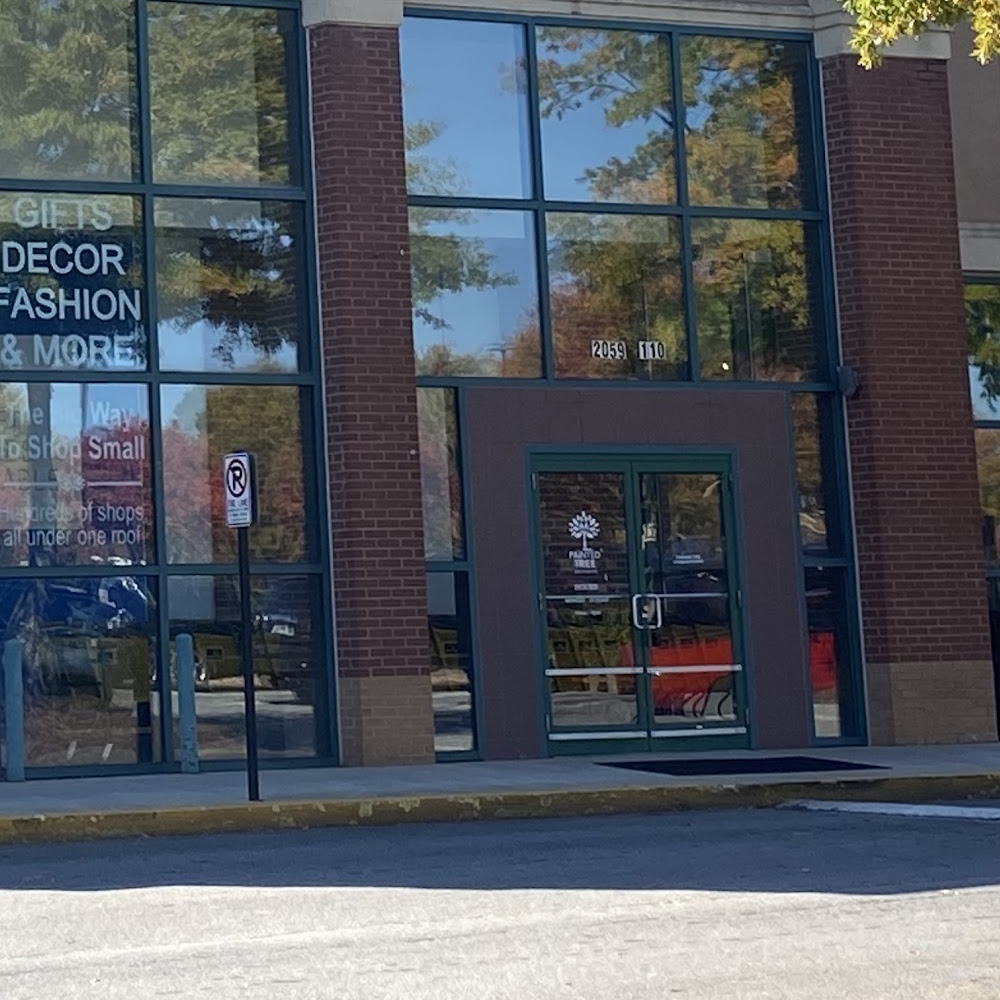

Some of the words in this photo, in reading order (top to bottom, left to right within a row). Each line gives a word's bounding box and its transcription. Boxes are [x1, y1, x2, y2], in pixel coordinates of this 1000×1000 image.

[13, 197, 113, 231] GIFTS
[1, 241, 126, 275] DECOR
[0, 333, 22, 367] &
[33, 333, 137, 368] MORE
[593, 341, 625, 359] 2059
[641, 342, 665, 358] 110
[7, 403, 44, 425] The
[28, 435, 81, 465] Shop
[88, 435, 146, 460] Small
[79, 502, 94, 521] of
[97, 503, 144, 527] shops
[3, 528, 21, 547] all
[27, 527, 70, 547] under
[77, 530, 107, 545] one
[111, 525, 142, 545] roof
